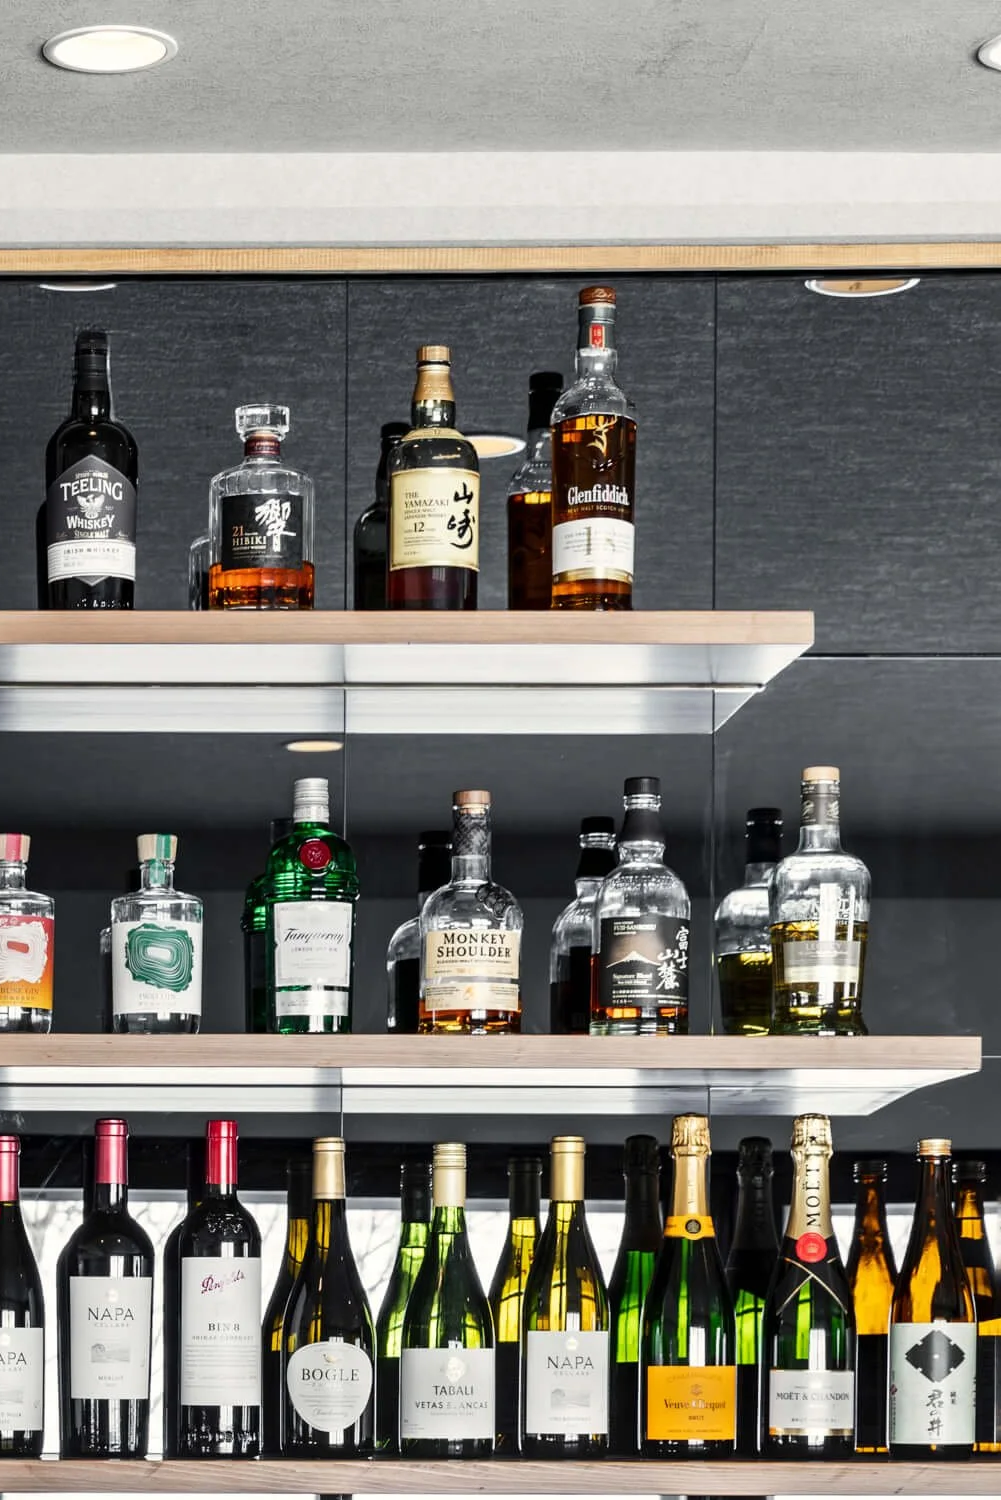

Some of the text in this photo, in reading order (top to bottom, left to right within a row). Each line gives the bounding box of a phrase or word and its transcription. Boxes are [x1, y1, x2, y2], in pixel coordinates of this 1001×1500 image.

[59, 478, 123, 502] TEELING
[403, 491, 420, 500] THE
[567, 483, 631, 506] Glenfiddich
[403, 499, 450, 509] YAMAZAKI
[65, 513, 116, 530] WHISKEY
[254, 498, 297, 553] 響
[412, 521, 425, 533] 12
[231, 525, 244, 537] 21
[232, 535, 267, 546] HIBIKI
[283, 927, 345, 944] Tanqueray
[443, 932, 507, 945] MONKEY
[436, 946, 511, 958] SHOULDER
[801, 1163, 821, 1228] MOËT
[87, 1306, 135, 1321] NAPA
[208, 1322, 241, 1332] BIN 8
[546, 1355, 595, 1370] NAPA
[301, 1367, 361, 1382] BOGLE
[431, 1385, 475, 1396] TABALI
[775, 1391, 851, 1401] MOËT & CHANDON
[414, 1400, 444, 1409] VETAS
[663, 1398, 690, 1409] Veuve
